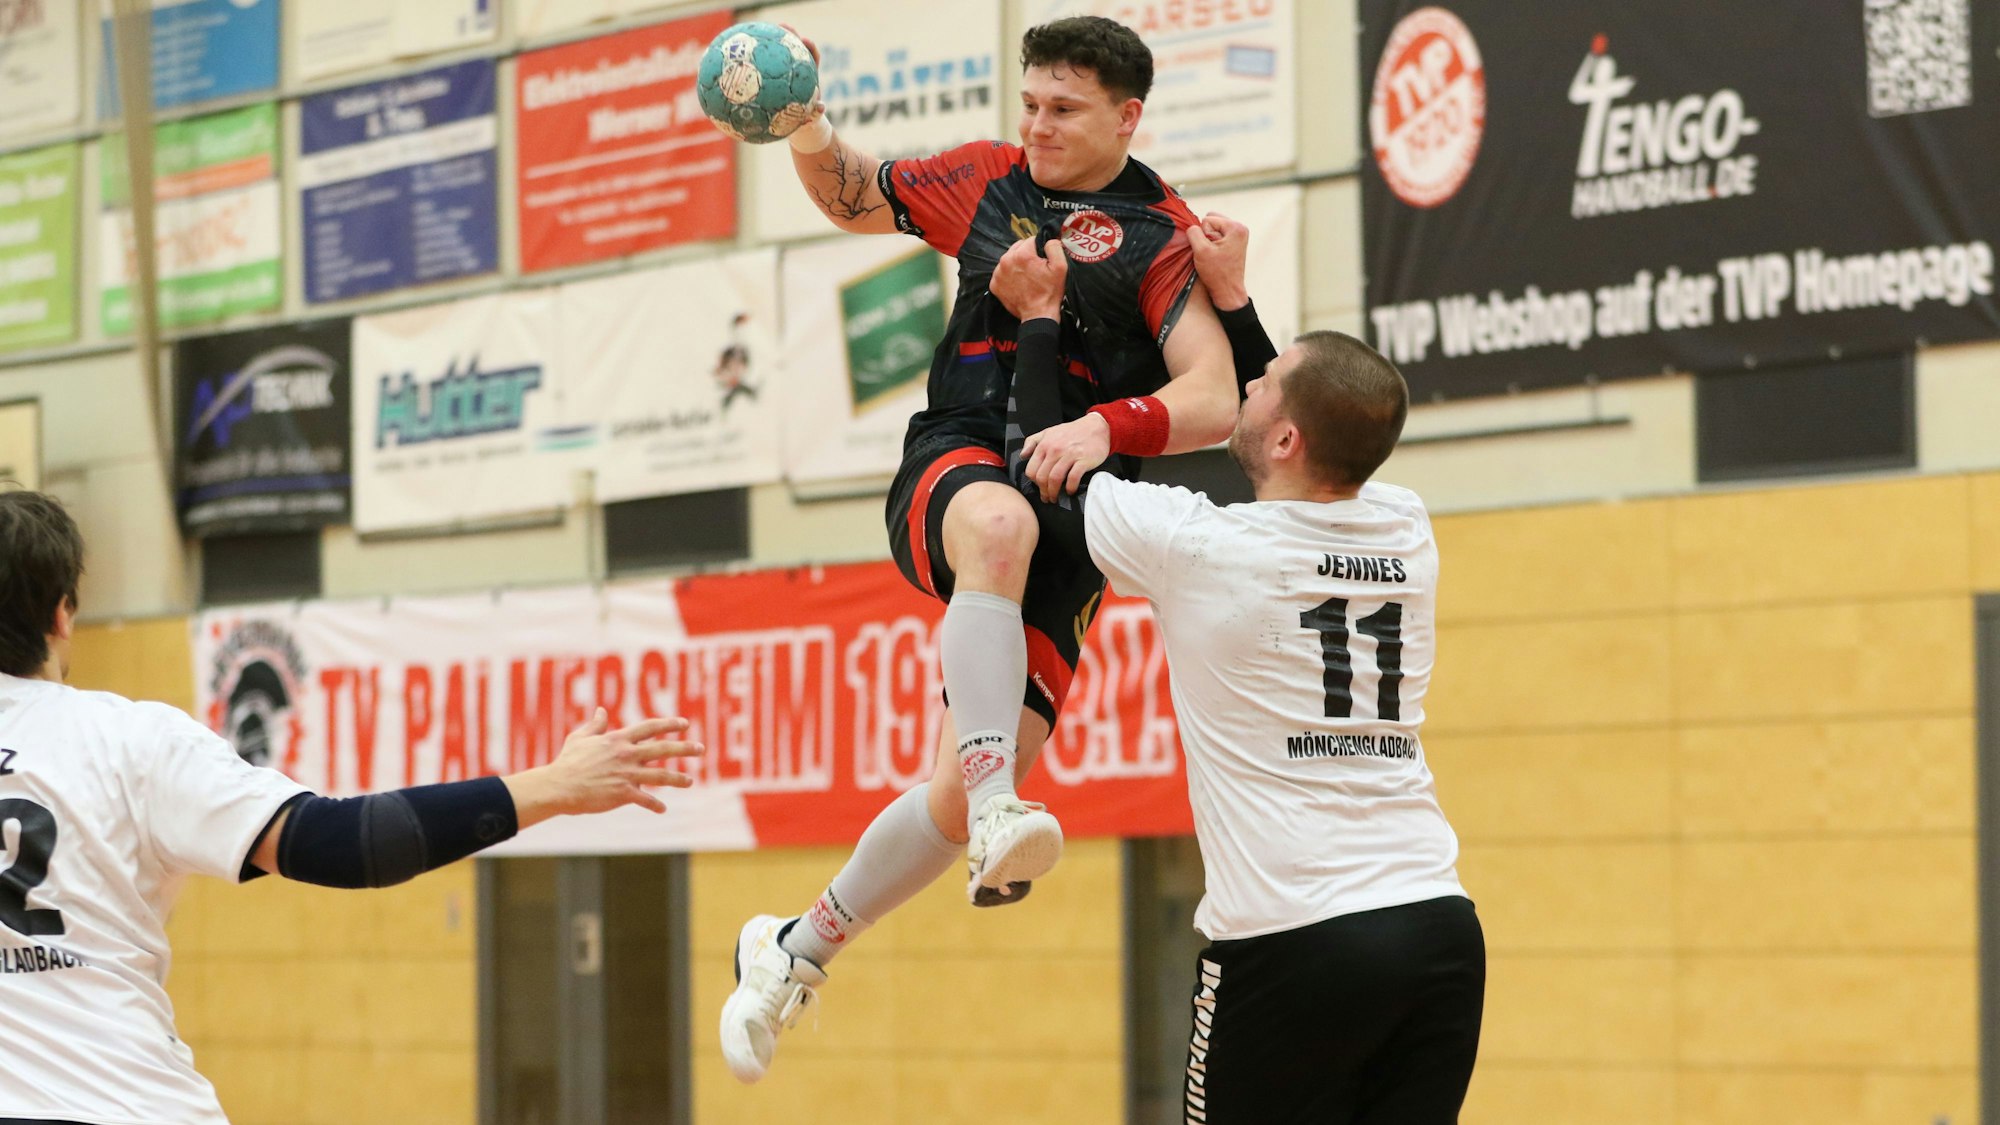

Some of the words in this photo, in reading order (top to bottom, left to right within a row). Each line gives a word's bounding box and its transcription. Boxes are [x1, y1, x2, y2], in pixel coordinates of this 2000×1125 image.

[1571, 155, 1758, 219] HANDBALL.DE
[1069, 231, 1100, 253] 1920
[1079, 217, 1114, 238] TVP
[1371, 305, 1437, 363] TVP
[1438, 286, 1592, 357] Webshop
[1596, 271, 1654, 336] auf
[1656, 267, 1716, 331] der
[1718, 253, 1790, 322] TVP
[1795, 241, 1994, 314] Homepage
[1317, 553, 1407, 583] JENNES
[1300, 597, 1405, 722] 11
[1033, 671, 1055, 702] Kempa
[319, 667, 380, 792] TV
[845, 615, 946, 792] 19
[0, 945, 90, 974] LADBAC
